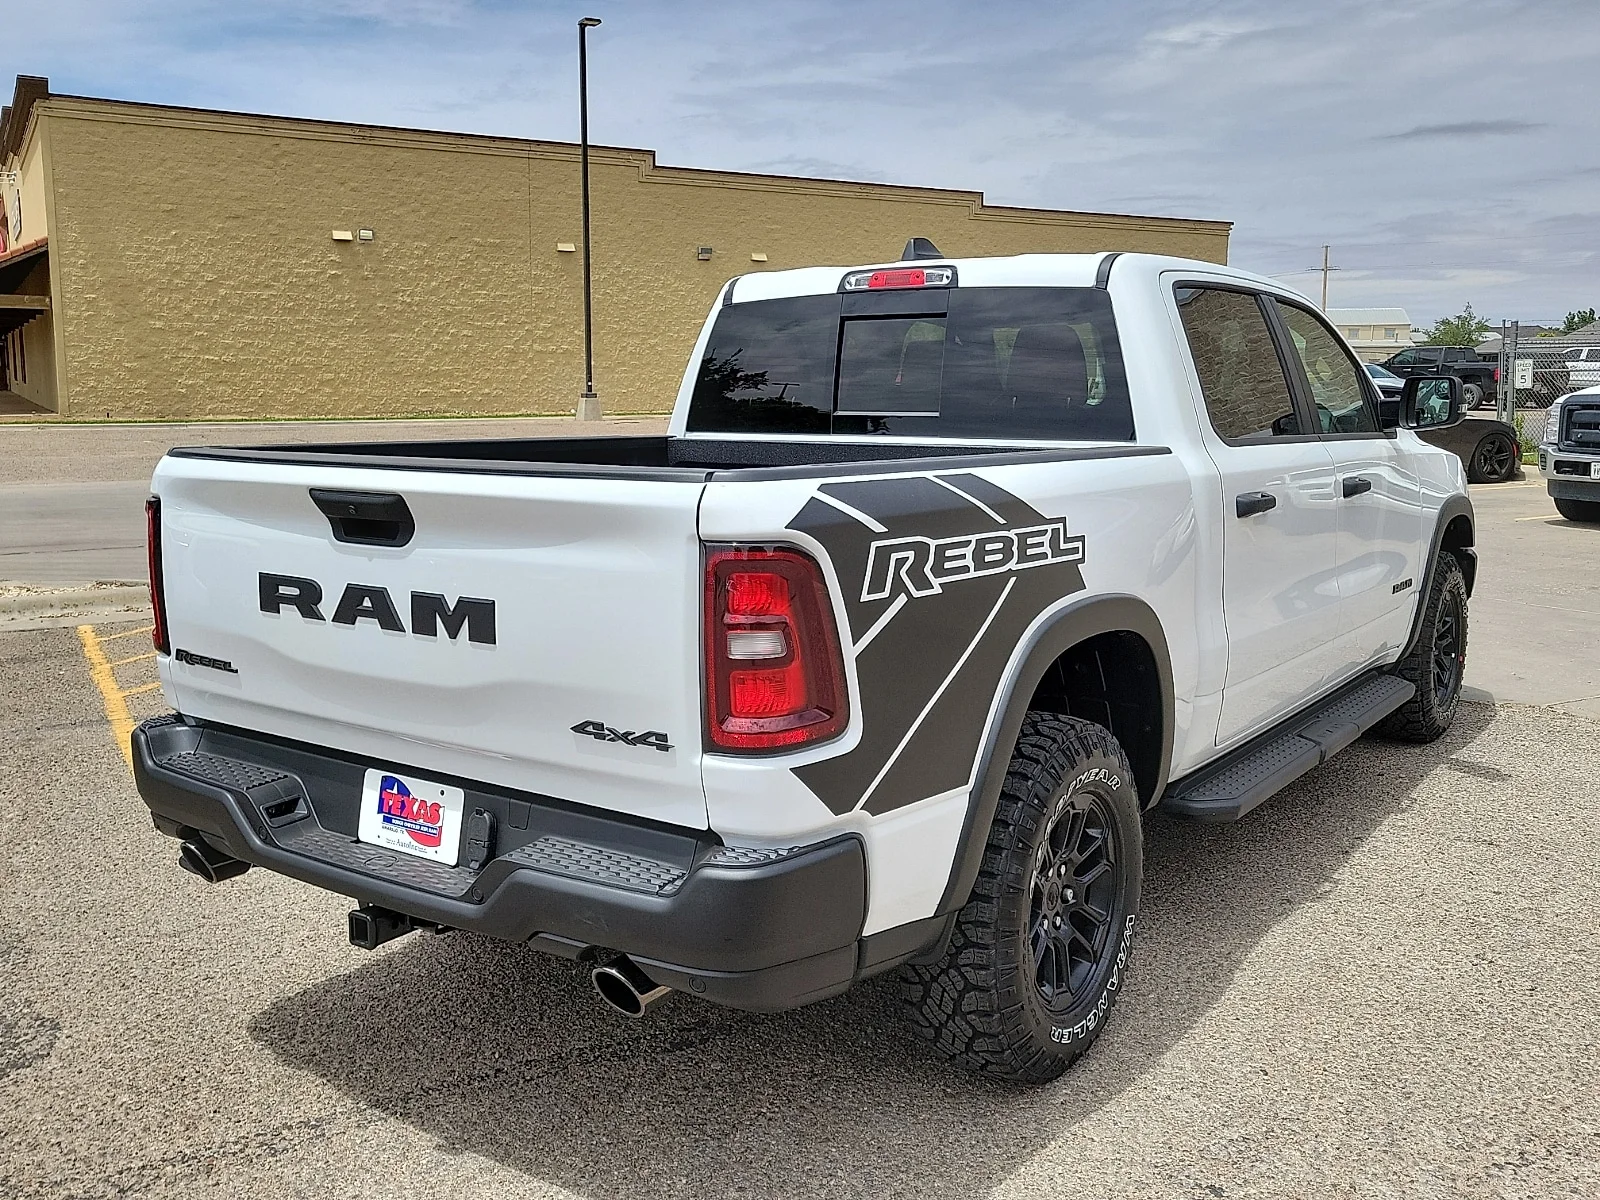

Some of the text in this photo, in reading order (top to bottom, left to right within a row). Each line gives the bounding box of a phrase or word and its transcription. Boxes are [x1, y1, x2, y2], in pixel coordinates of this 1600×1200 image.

[1520, 375, 1527, 384] 5
[860, 517, 1085, 603] REBEL
[1392, 577, 1413, 595] RAM
[258, 571, 497, 645] RAM
[175, 647, 239, 674] REBEL
[382, 791, 441, 825] TEXAS
[1050, 914, 1136, 1044] WRANGLER
